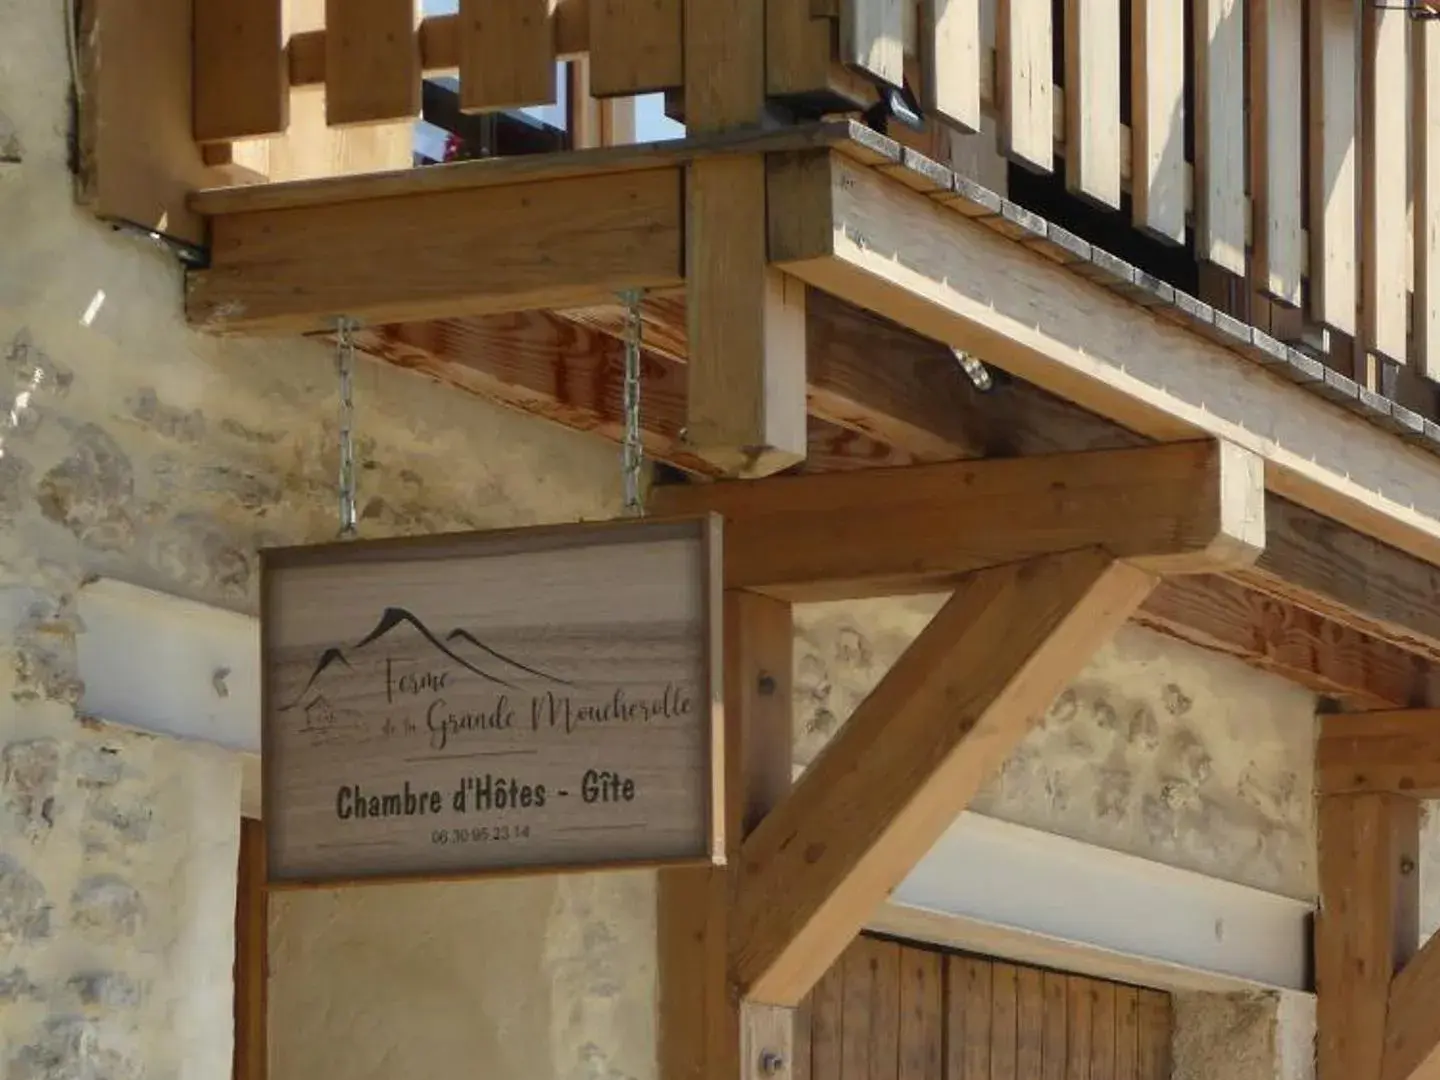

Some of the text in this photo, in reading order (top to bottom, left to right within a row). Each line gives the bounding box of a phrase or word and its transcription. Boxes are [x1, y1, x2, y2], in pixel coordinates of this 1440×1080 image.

[426, 694, 515, 750] Grande
[336, 780, 442, 820] Chambre
[452, 774, 546, 813] d'Hôtes
[581, 769, 635, 803] Gîte
